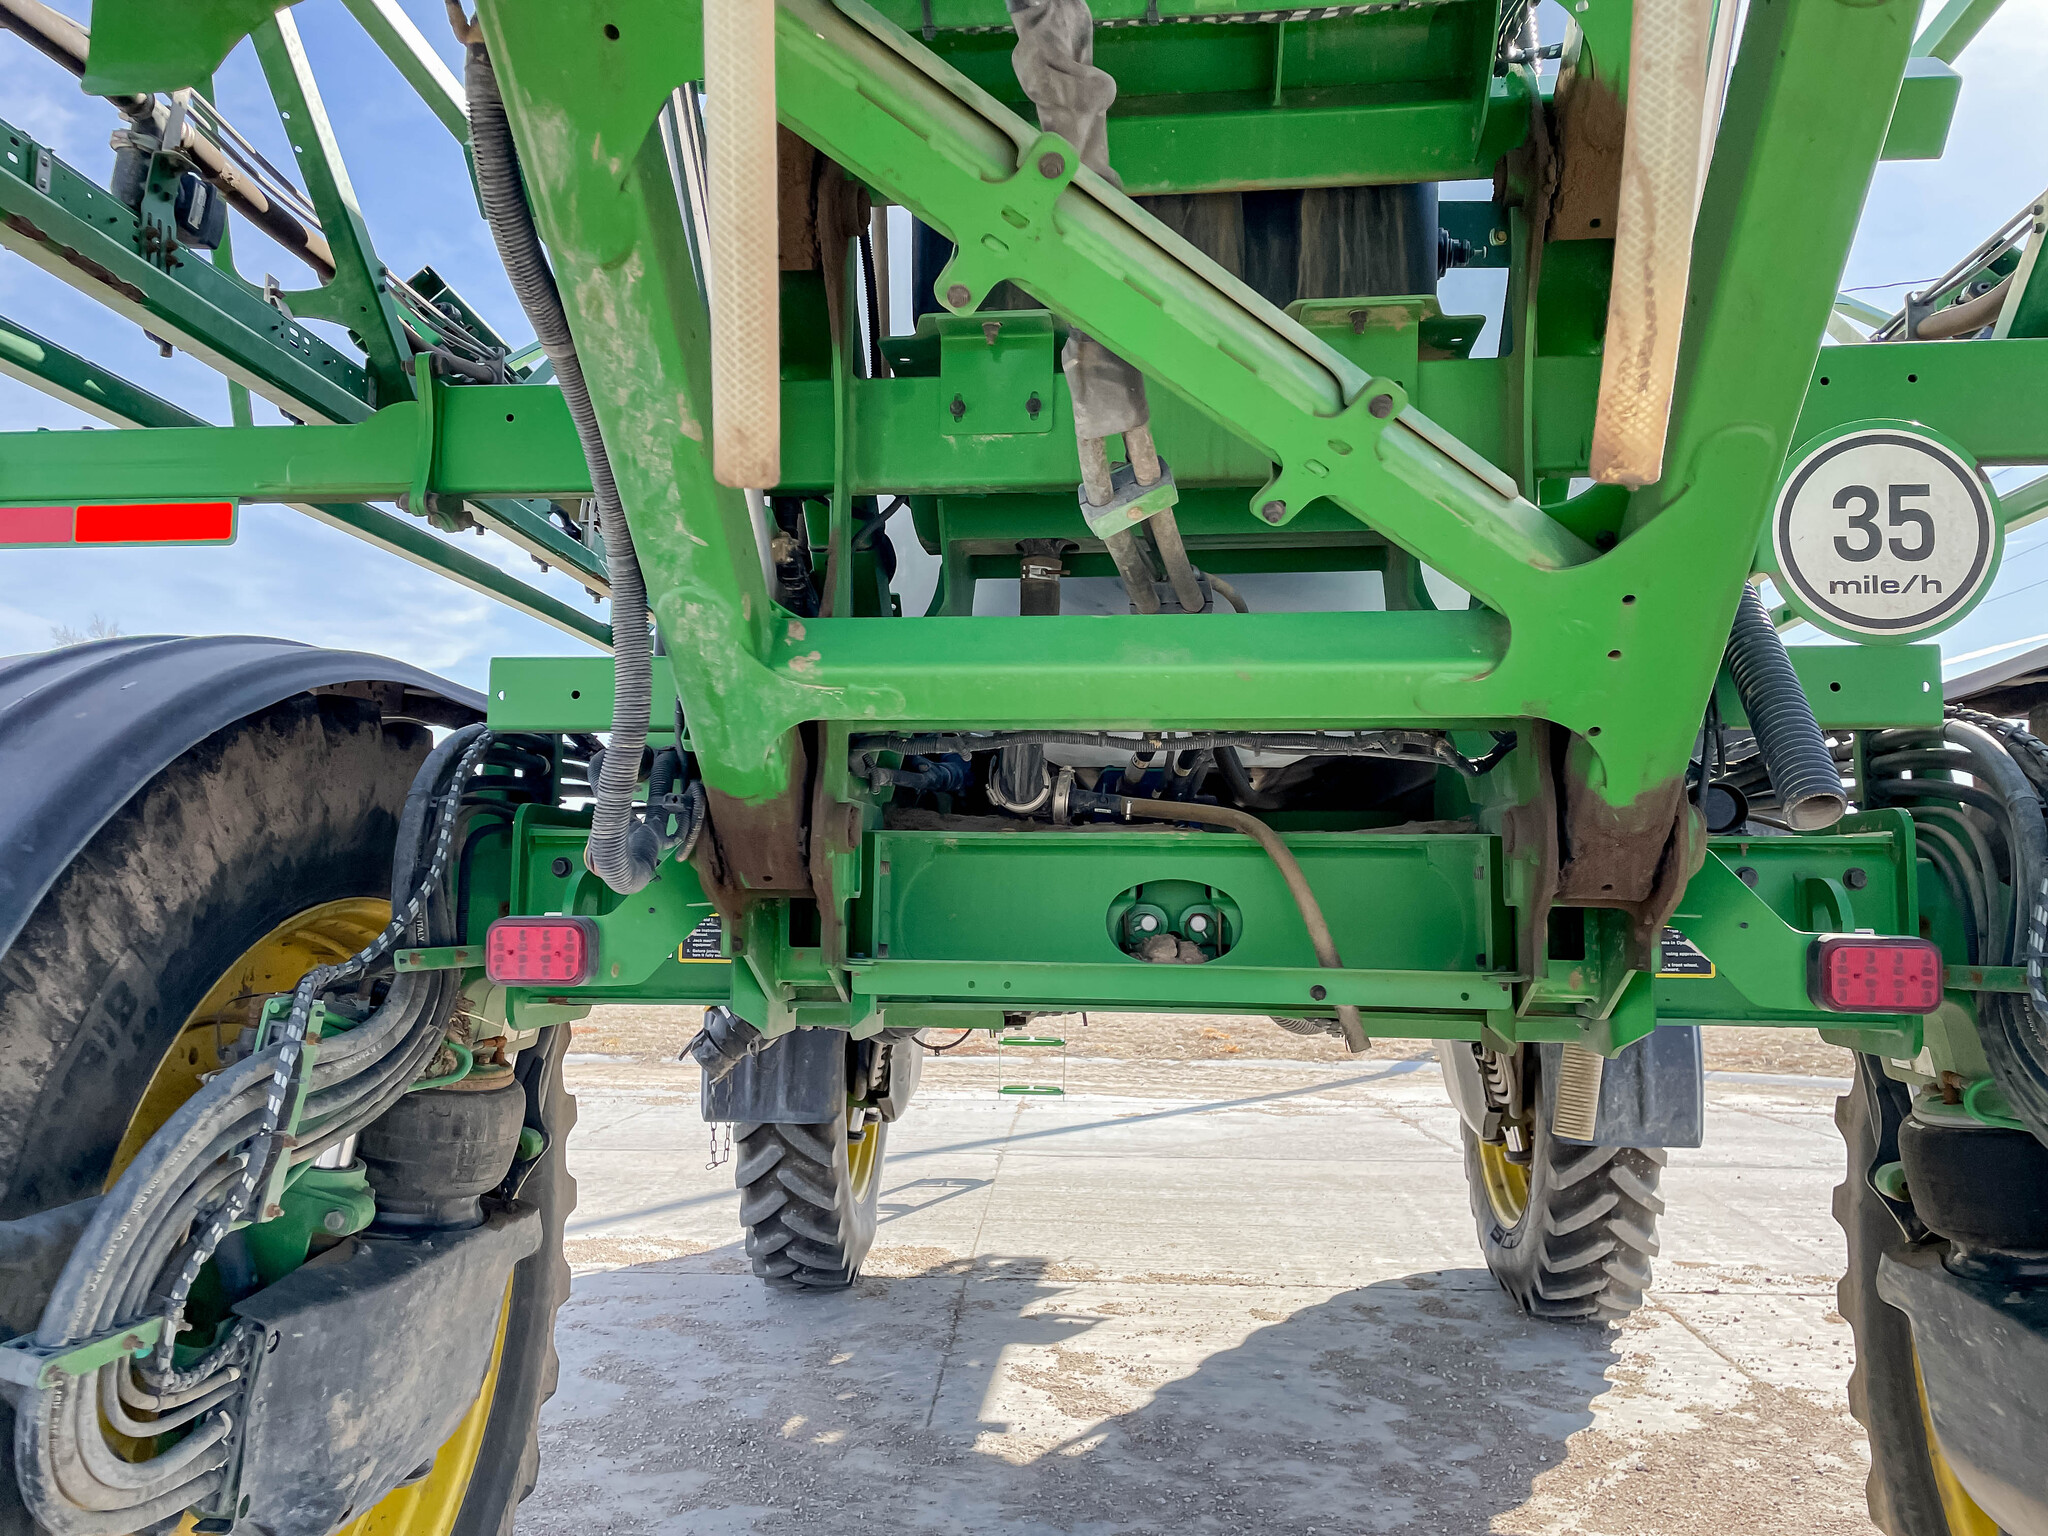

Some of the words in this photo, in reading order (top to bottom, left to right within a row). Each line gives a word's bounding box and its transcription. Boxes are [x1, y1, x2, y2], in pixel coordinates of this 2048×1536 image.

[1832, 483, 1935, 563] 35
[1829, 574, 1942, 595] mile/h
[416, 920, 425, 942] ITALY
